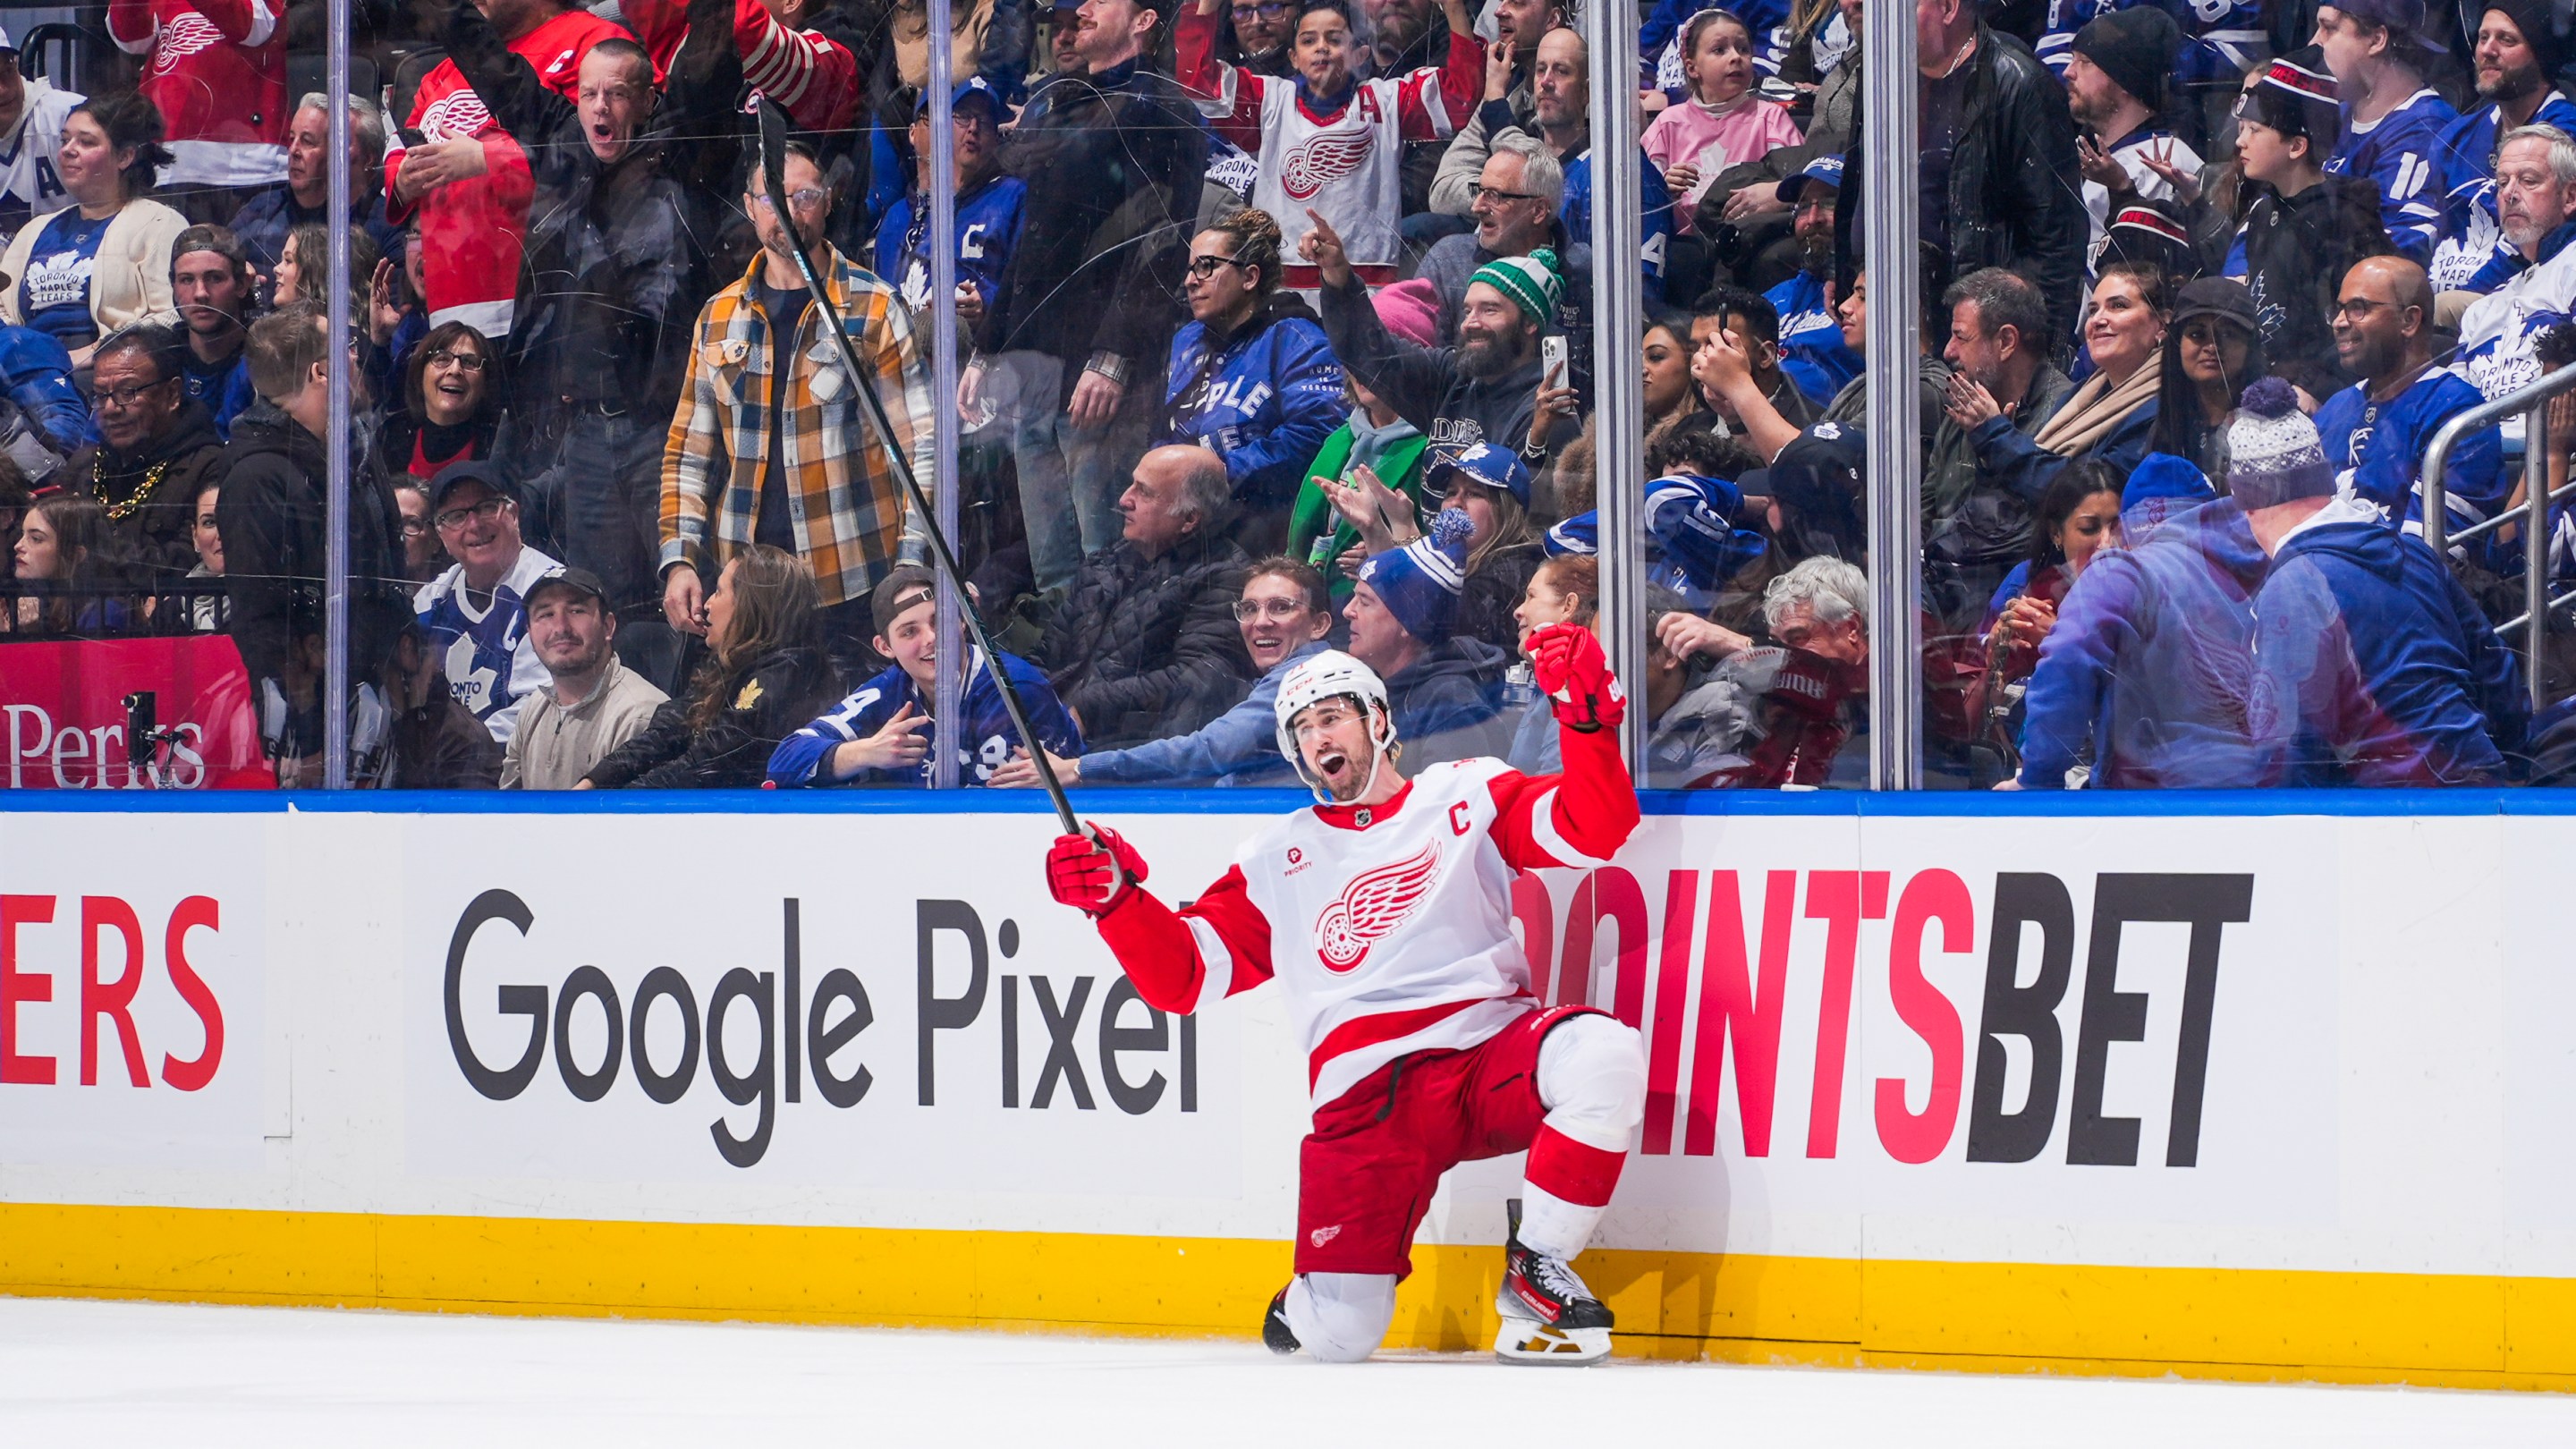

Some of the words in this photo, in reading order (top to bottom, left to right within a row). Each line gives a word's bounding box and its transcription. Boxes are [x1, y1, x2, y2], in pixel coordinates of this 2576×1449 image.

[1357, 84, 1383, 123] A
[35, 156, 67, 199] A
[1210, 160, 1258, 177] TORONT
[1641, 232, 1666, 278] 4
[2438, 255, 2486, 270] TORON
[34, 272, 79, 285] TORONTO
[2439, 269, 2472, 282] MAPL
[39, 283, 72, 292] MAPLE
[40, 292, 72, 302] LEAFS
[1194, 375, 1274, 419] PLE
[450, 682, 481, 695] ONTO
[1287, 677, 1313, 696] CCM
[1448, 800, 1471, 837] C
[1284, 860, 1312, 877] PRIORITY
[0, 894, 225, 1092] ERS
[445, 889, 873, 1168] Google
